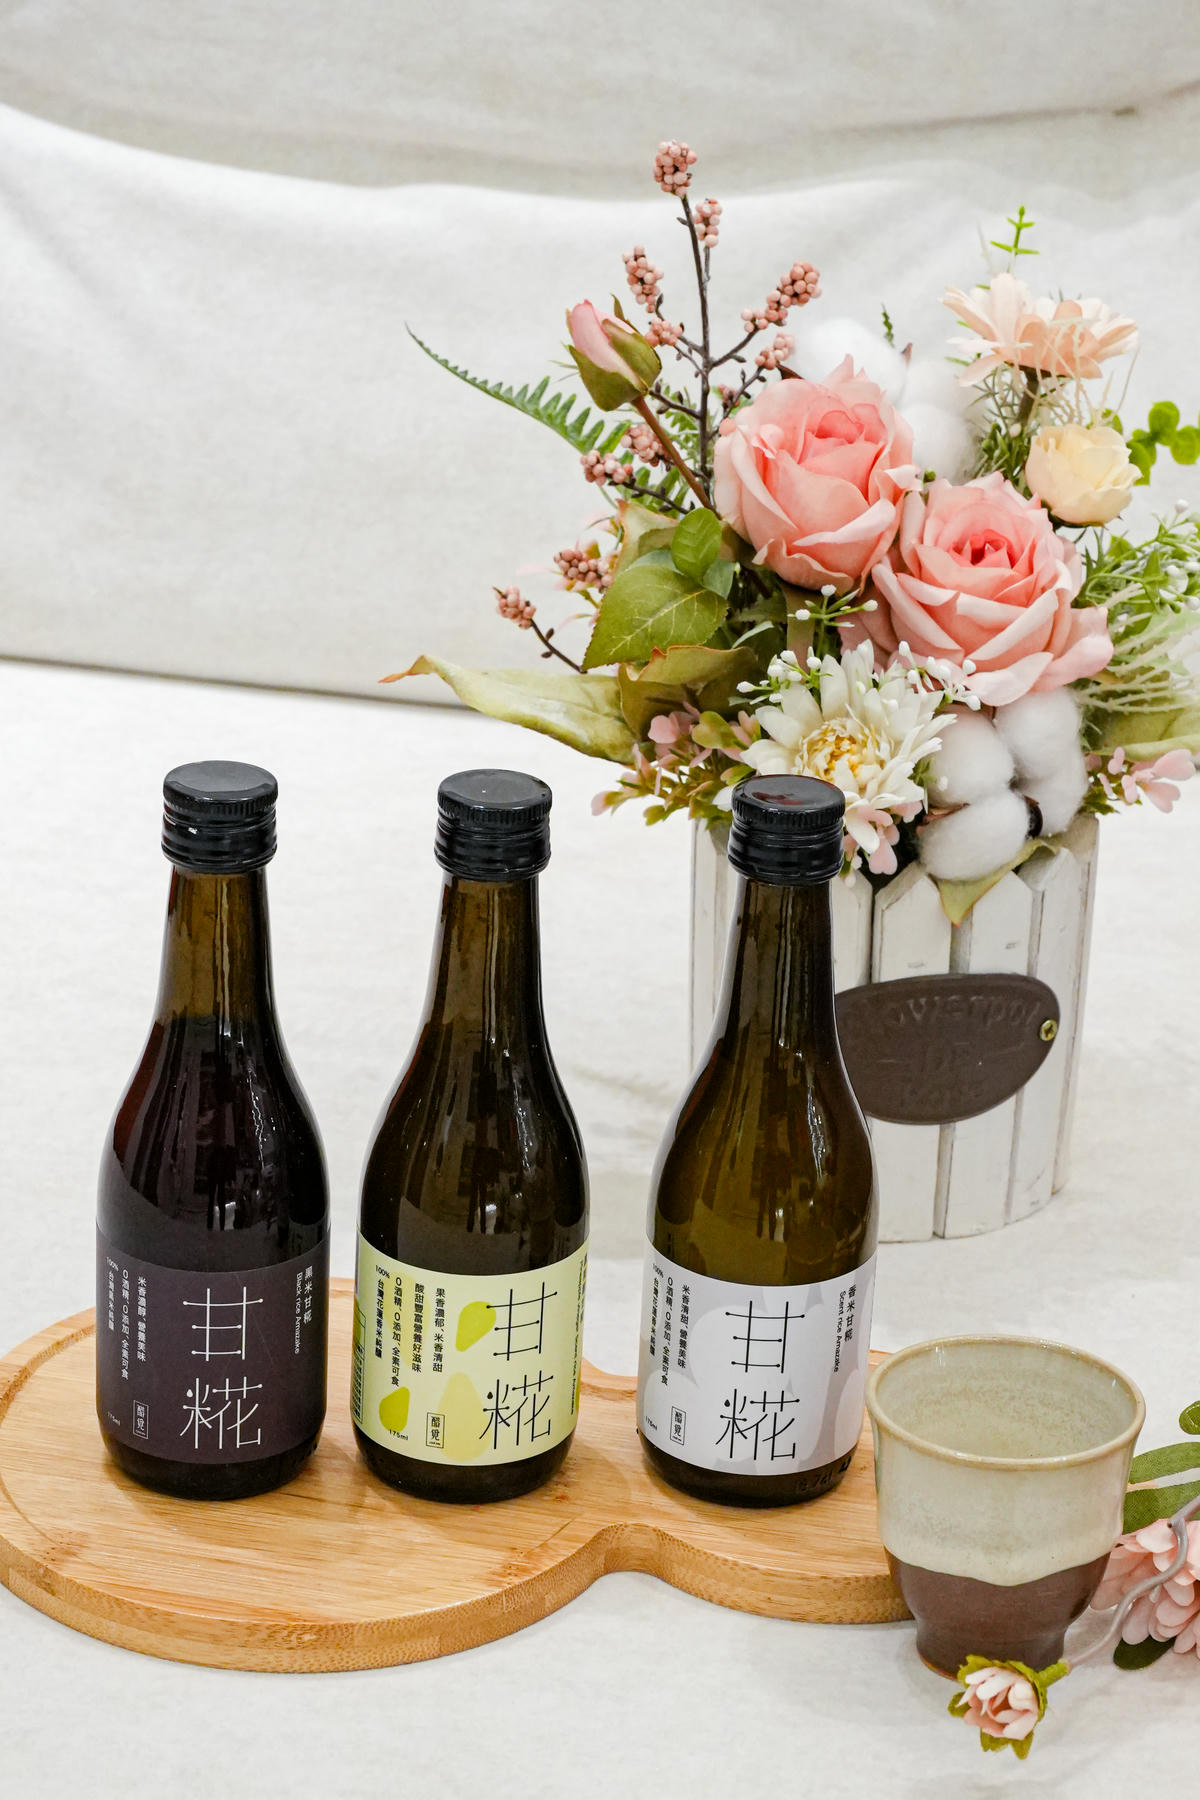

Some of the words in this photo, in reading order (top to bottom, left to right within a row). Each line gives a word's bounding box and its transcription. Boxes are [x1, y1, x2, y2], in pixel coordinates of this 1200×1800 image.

[106, 1256, 119, 1272] 100%
[375, 1265, 390, 1279] 100%
[653, 1264, 664, 1279] 100%
[295, 1271, 303, 1297] Black
[838, 1290, 847, 1316] Scent
[836, 1317, 844, 1334] rice
[294, 1316, 302, 1355] Amazake
[833, 1335, 843, 1373] Amazake
[389, 1428, 408, 1441] 175ml
